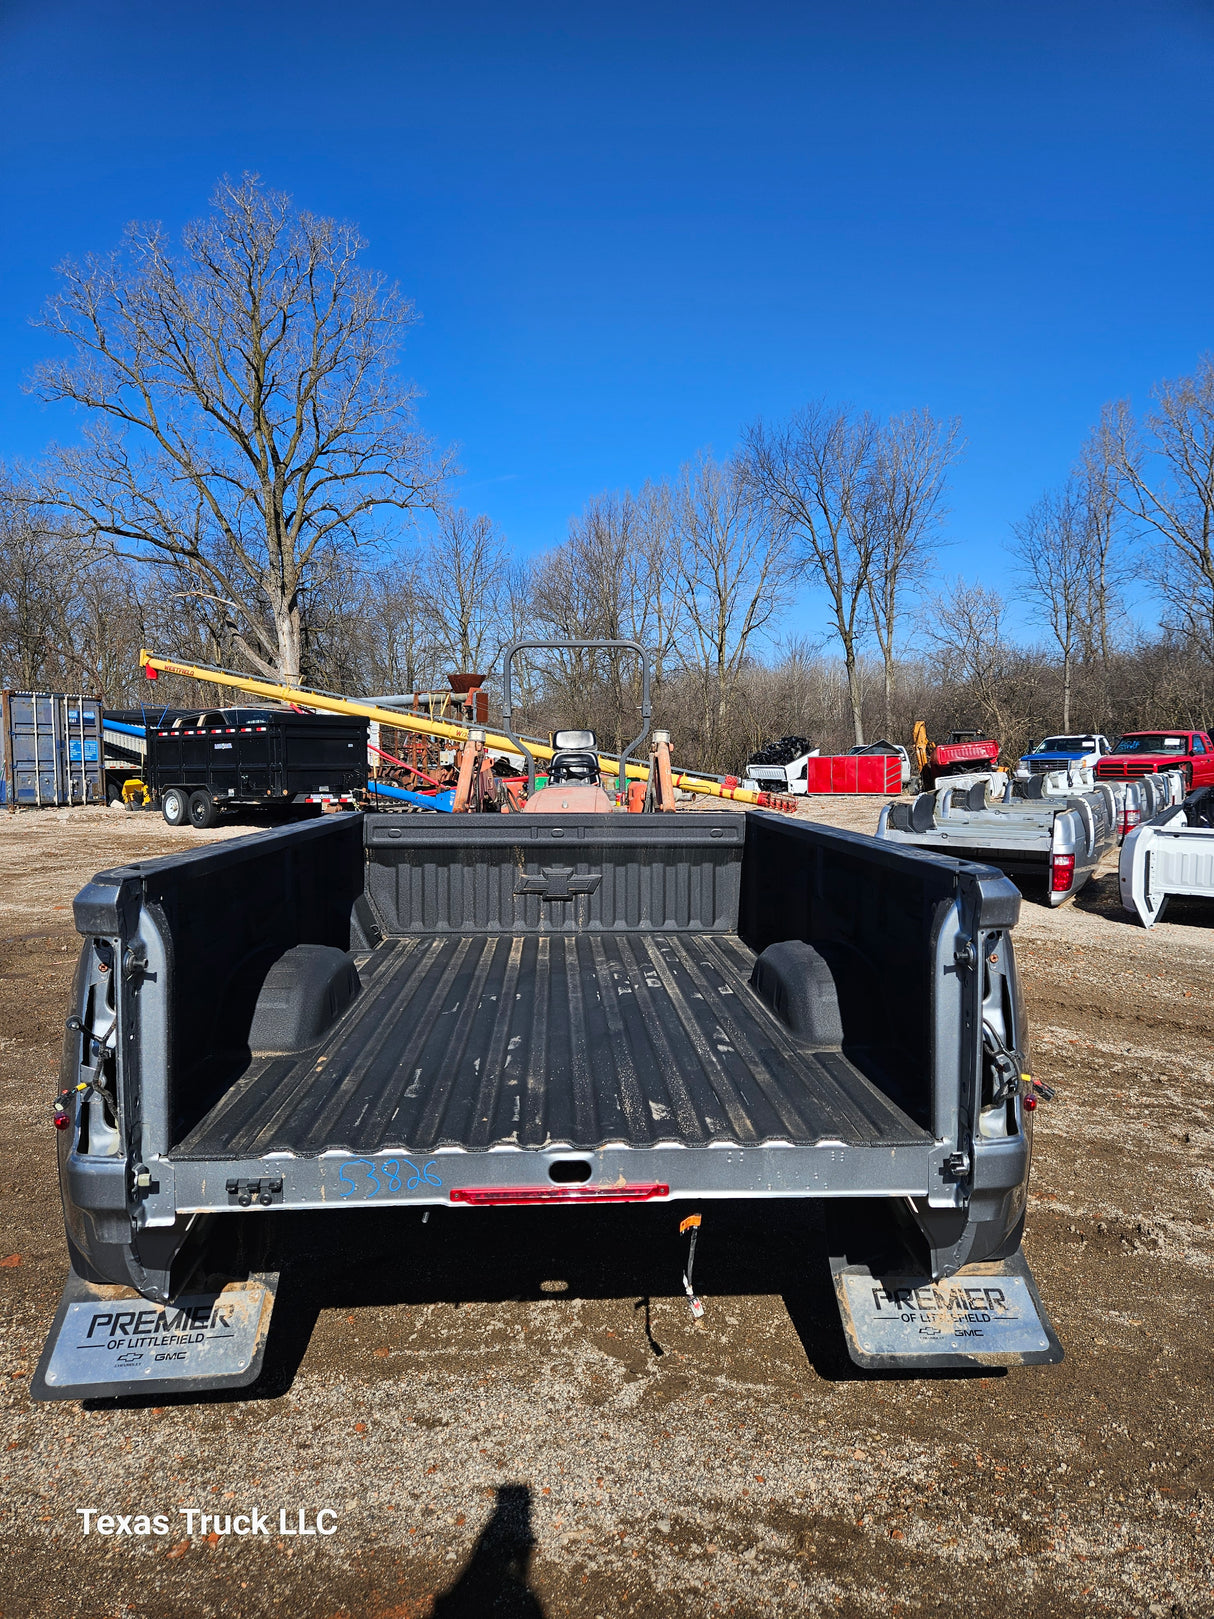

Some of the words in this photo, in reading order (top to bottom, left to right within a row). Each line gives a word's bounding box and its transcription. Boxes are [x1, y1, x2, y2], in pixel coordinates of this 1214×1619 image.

[339, 1158, 443, 1198] 53826
[872, 1287, 1010, 1311] PREMIER
[86, 1304, 235, 1339] PREMIER
[900, 1313, 917, 1323] OF
[919, 1313, 991, 1323] LITEFIELD
[107, 1339, 126, 1350] OF
[128, 1333, 205, 1349] LITTLEFIELD
[954, 1329, 984, 1337] GMC
[155, 1352, 187, 1361] GMC
